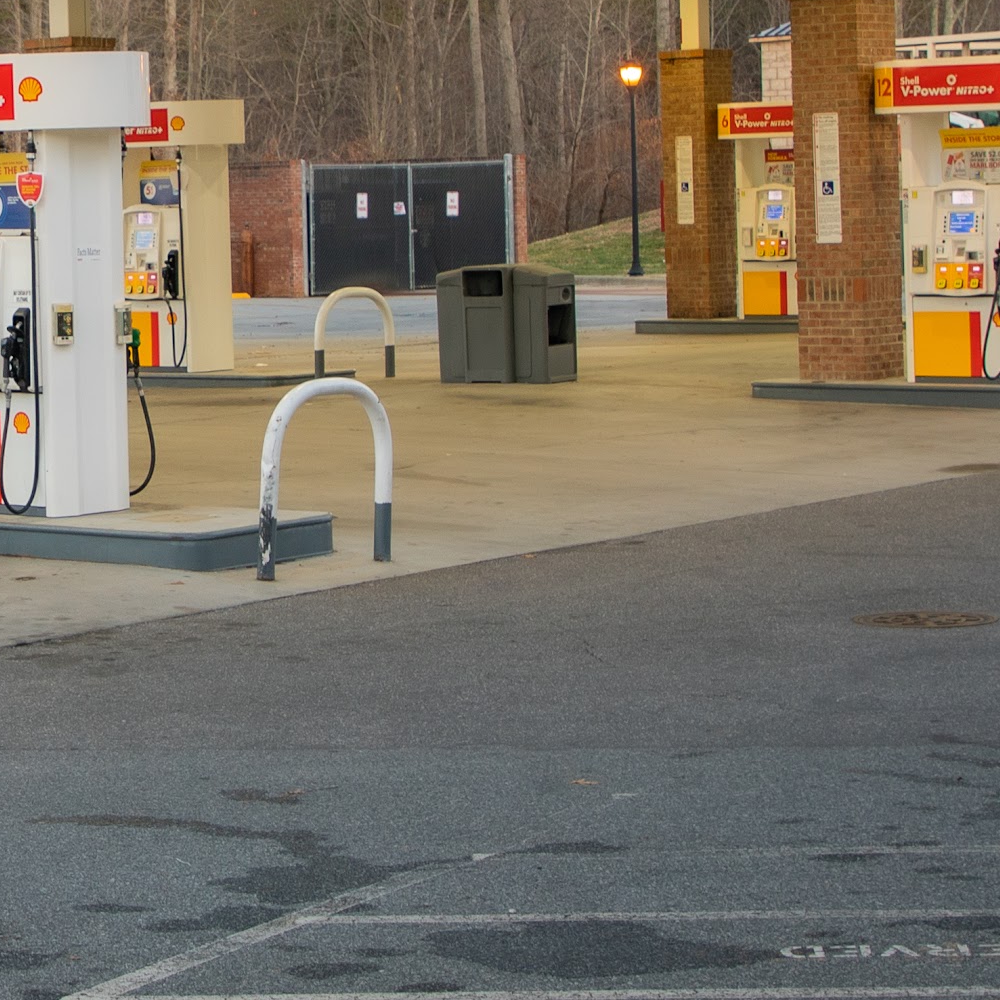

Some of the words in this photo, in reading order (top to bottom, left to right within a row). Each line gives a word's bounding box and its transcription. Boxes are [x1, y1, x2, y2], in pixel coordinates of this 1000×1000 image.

[900, 76, 920, 85] Shell
[877, 78, 891, 97] 12
[900, 86, 953, 97] V-Power
[721, 116, 729, 128] 6
[734, 120, 769, 128] V-Power
[944, 136, 967, 144] INSIDE
[969, 135, 982, 143] THE
[4, 166, 17, 176] THE
